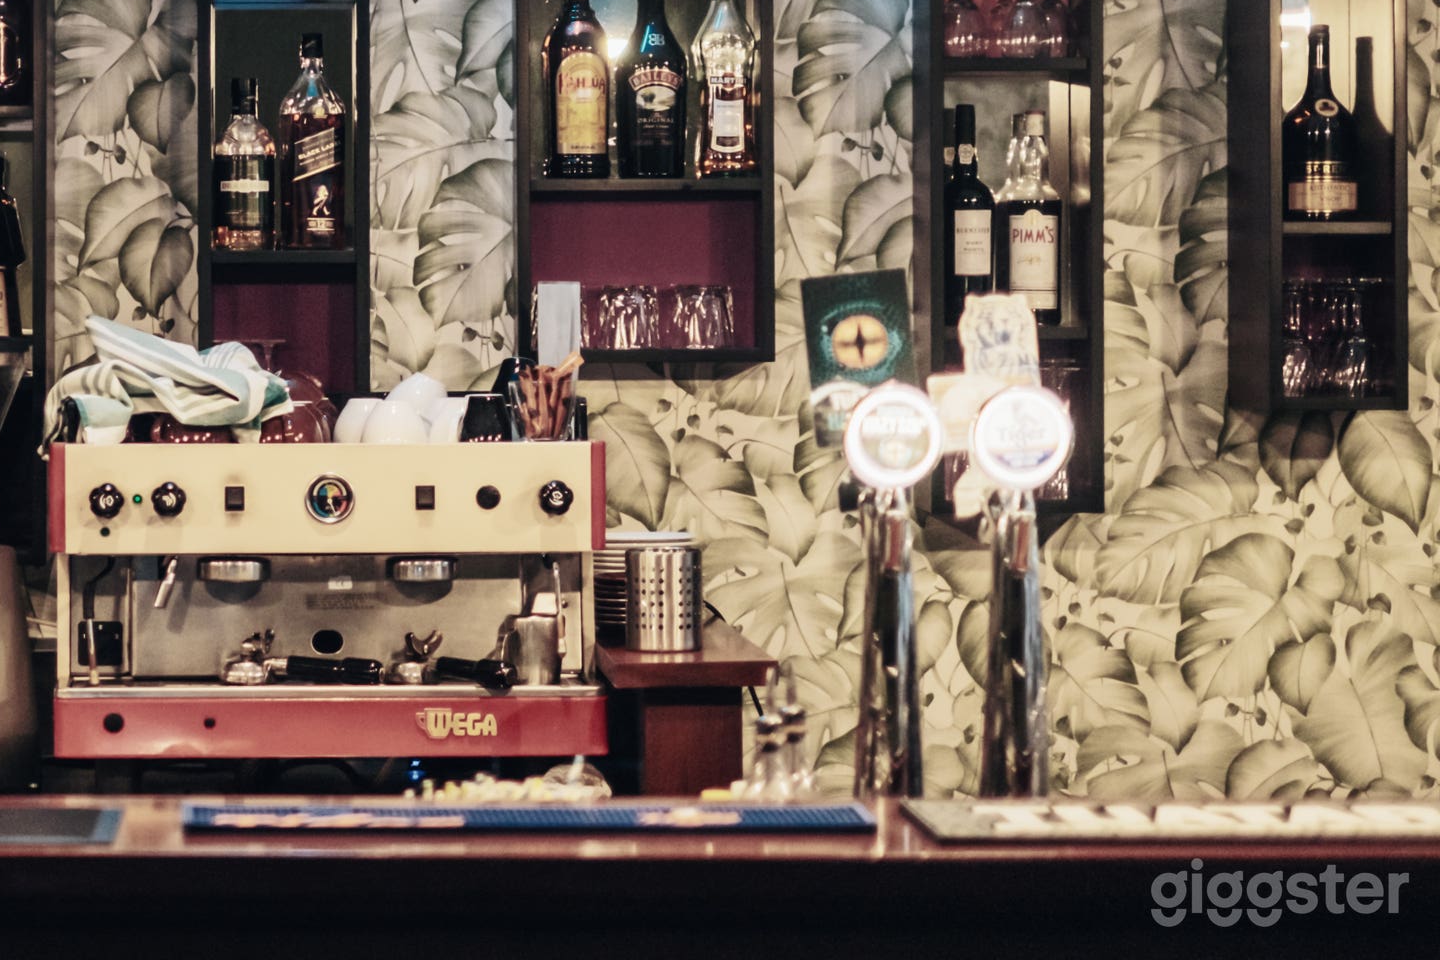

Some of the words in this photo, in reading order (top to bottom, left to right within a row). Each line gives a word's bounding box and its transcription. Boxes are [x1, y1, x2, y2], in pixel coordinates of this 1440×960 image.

[631, 68, 679, 88] BAILEYS
[298, 147, 321, 160] BLACK
[1012, 225, 1055, 244] PIMM'S
[426, 710, 498, 737] WEGA
